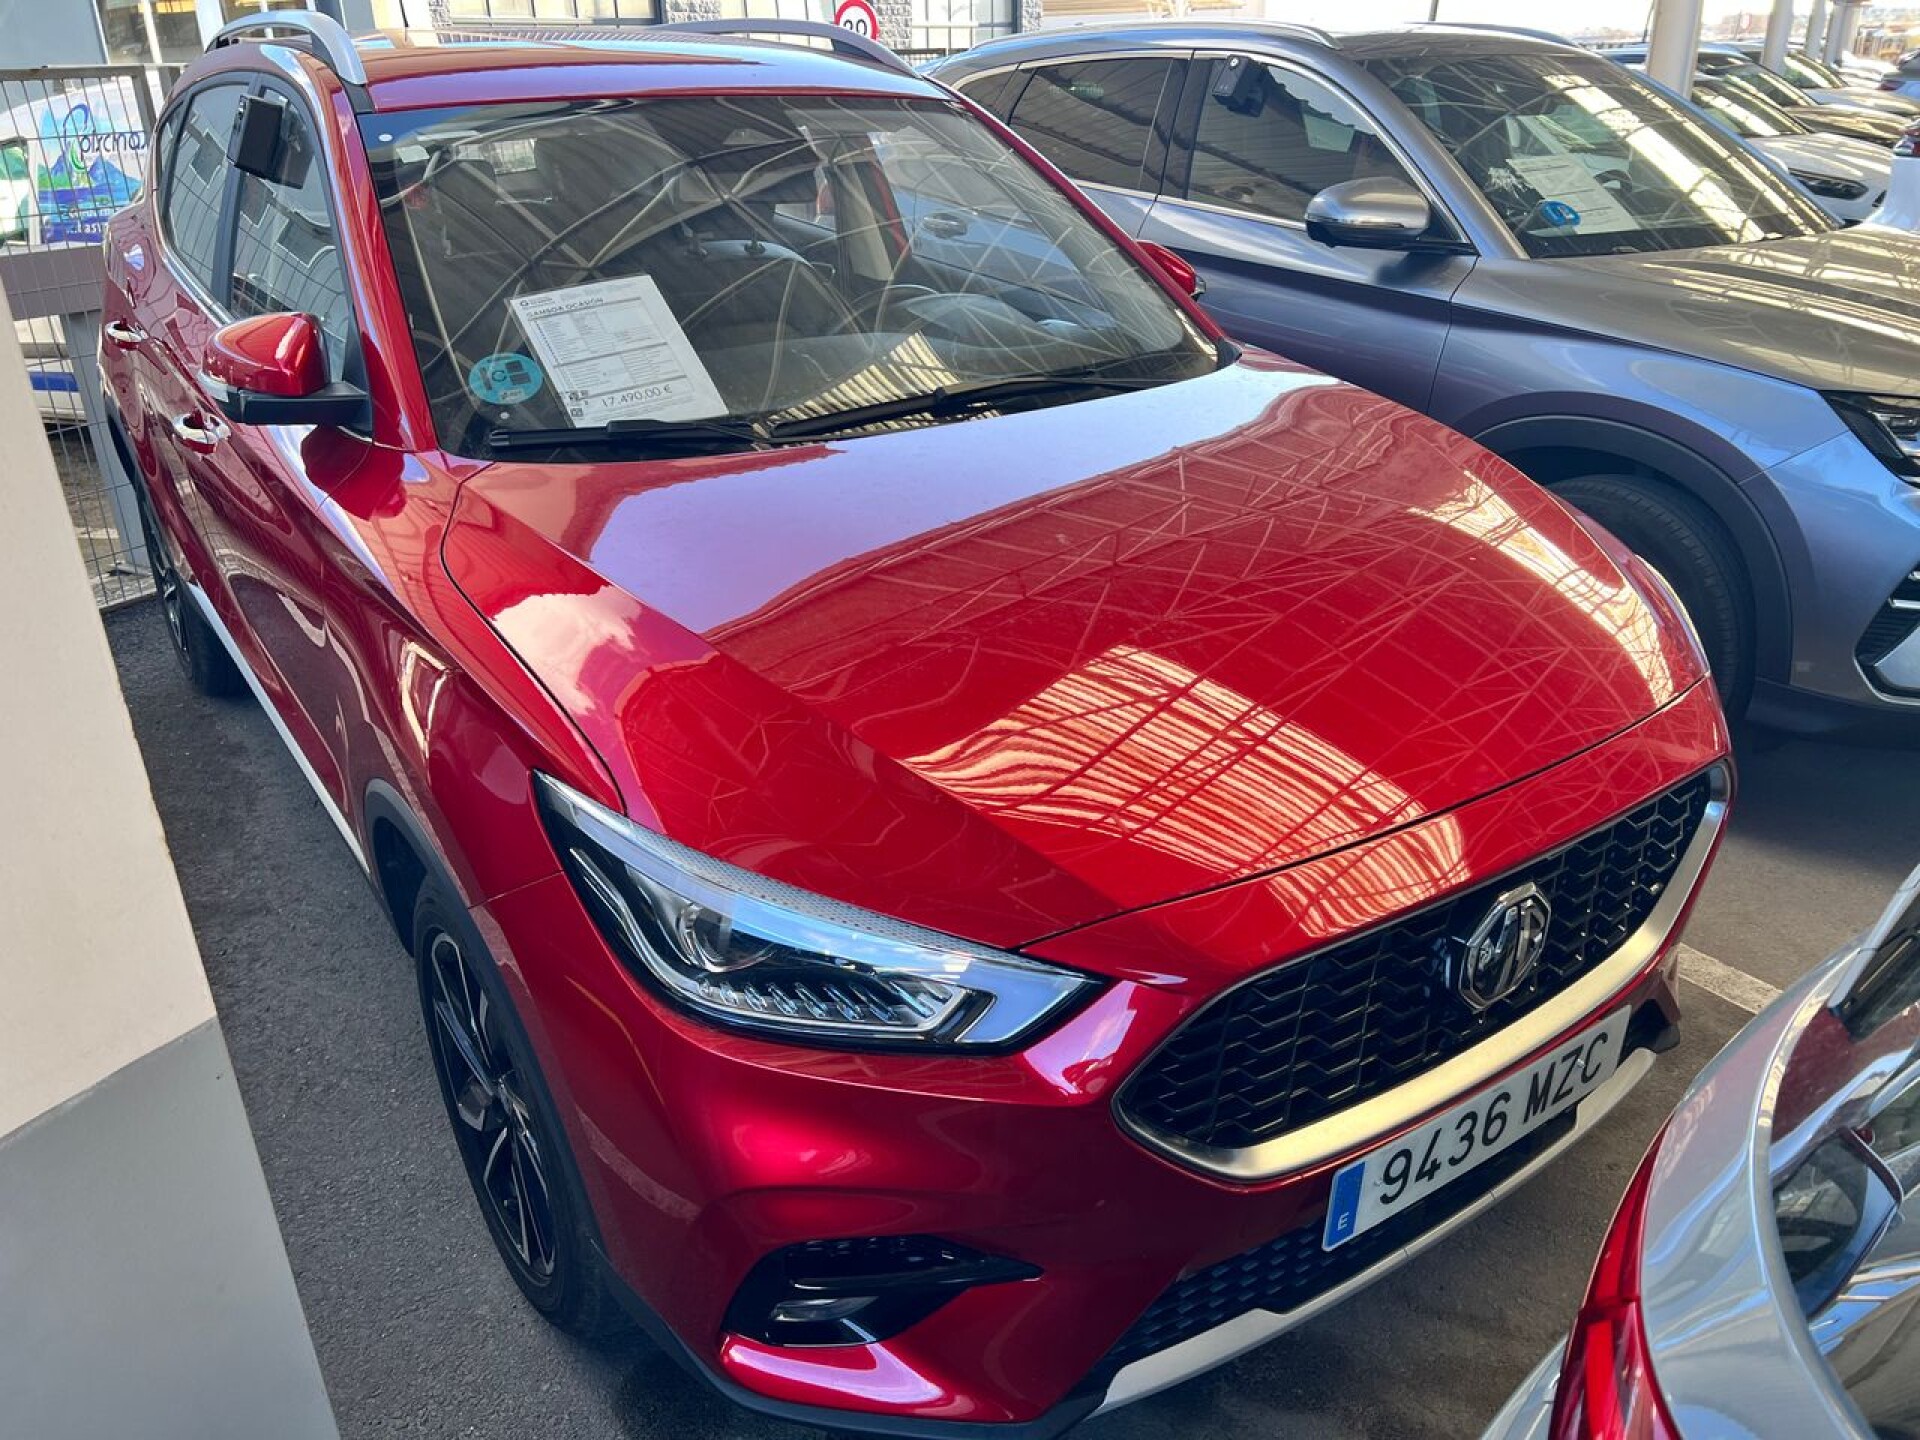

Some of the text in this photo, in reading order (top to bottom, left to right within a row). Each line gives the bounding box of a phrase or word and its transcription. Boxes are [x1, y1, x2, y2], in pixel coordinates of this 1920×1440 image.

[1337, 1032, 1609, 1230] E 9436 MZC
